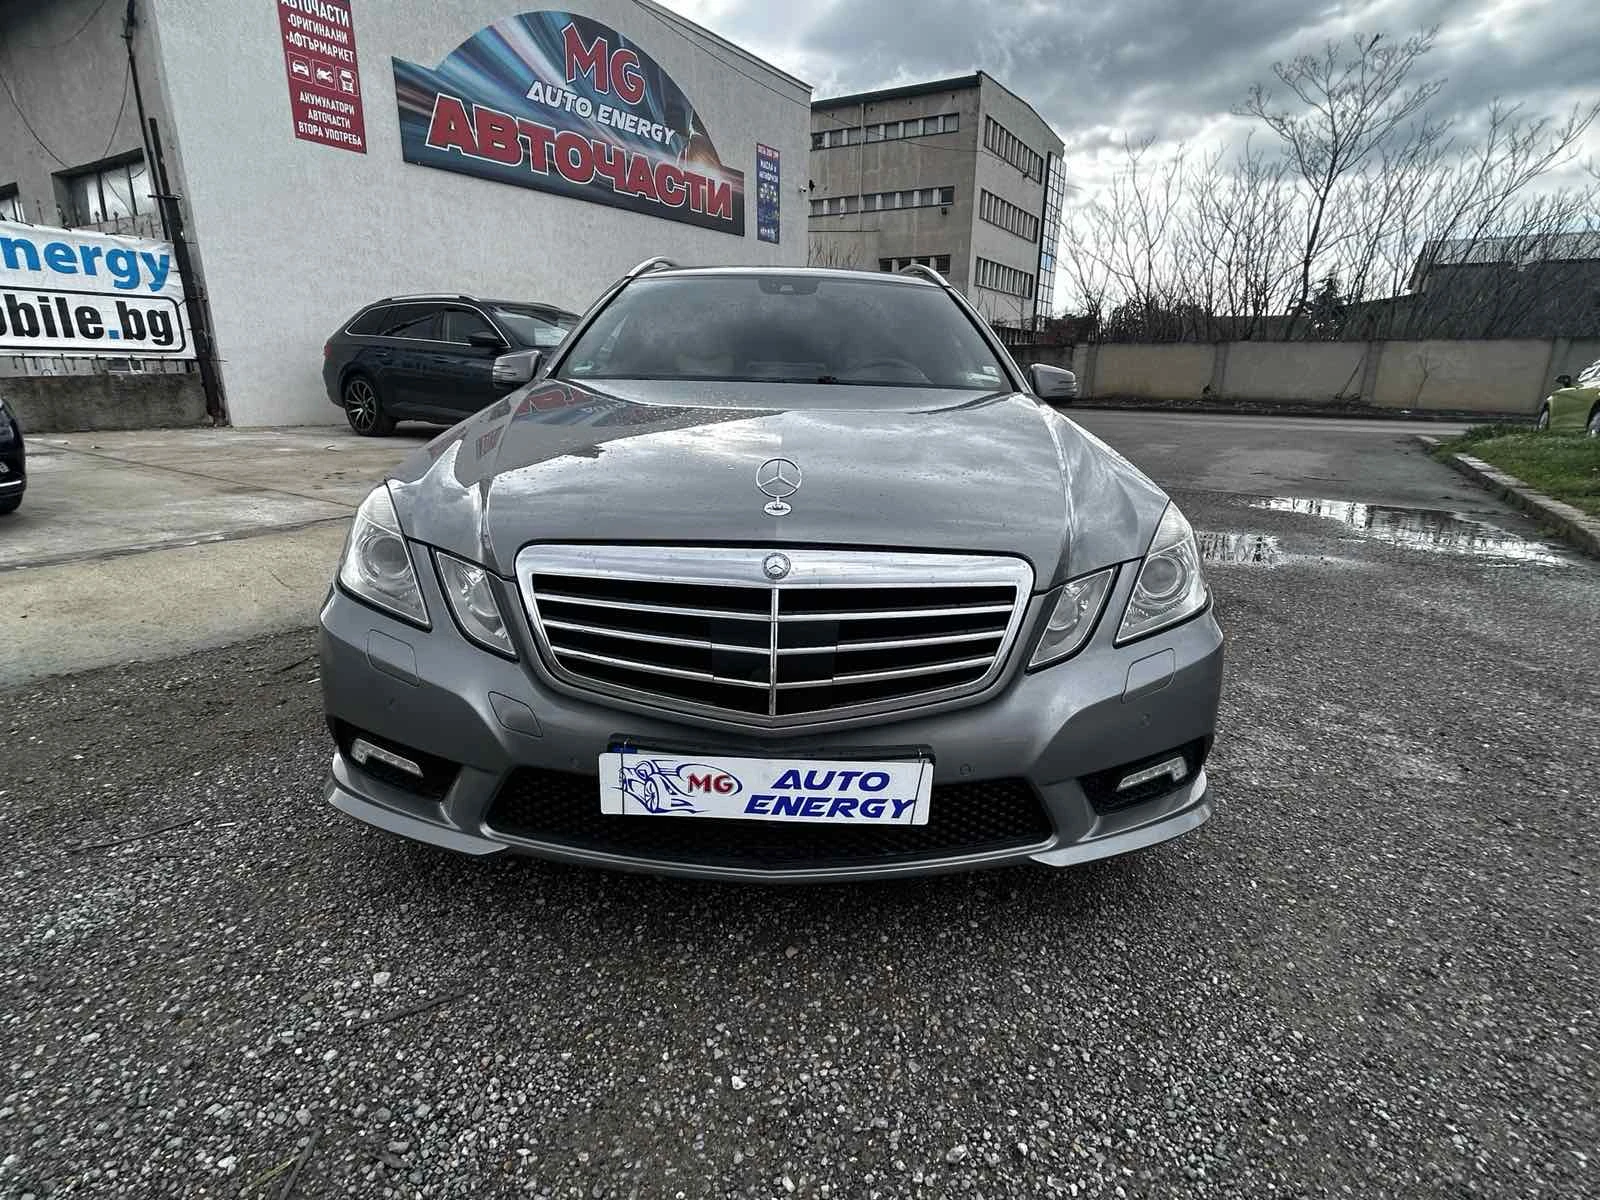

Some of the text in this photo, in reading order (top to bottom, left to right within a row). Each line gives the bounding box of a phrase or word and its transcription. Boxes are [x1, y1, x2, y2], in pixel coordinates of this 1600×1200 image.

[289, 13, 348, 44] ОРИГИНАЛНИ
[288, 31, 354, 63] АФТЪРМАРКЕТ
[561, 22, 646, 105] MG
[299, 91, 355, 115] АКУМУЛАТОРИ
[526, 80, 676, 145] AUTO ENERGY
[298, 121, 362, 146] ВТОРА УПОТРЕБА
[308, 109, 351, 129] АВТОЧАСТИ
[425, 92, 733, 220] АВТОЧАСТИ
[0, 237, 170, 292] nergy
[0, 294, 174, 346] bile.bg
[687, 773, 734, 795] MG
[771, 769, 890, 791] AUTO
[744, 795, 915, 818] ENERGY
